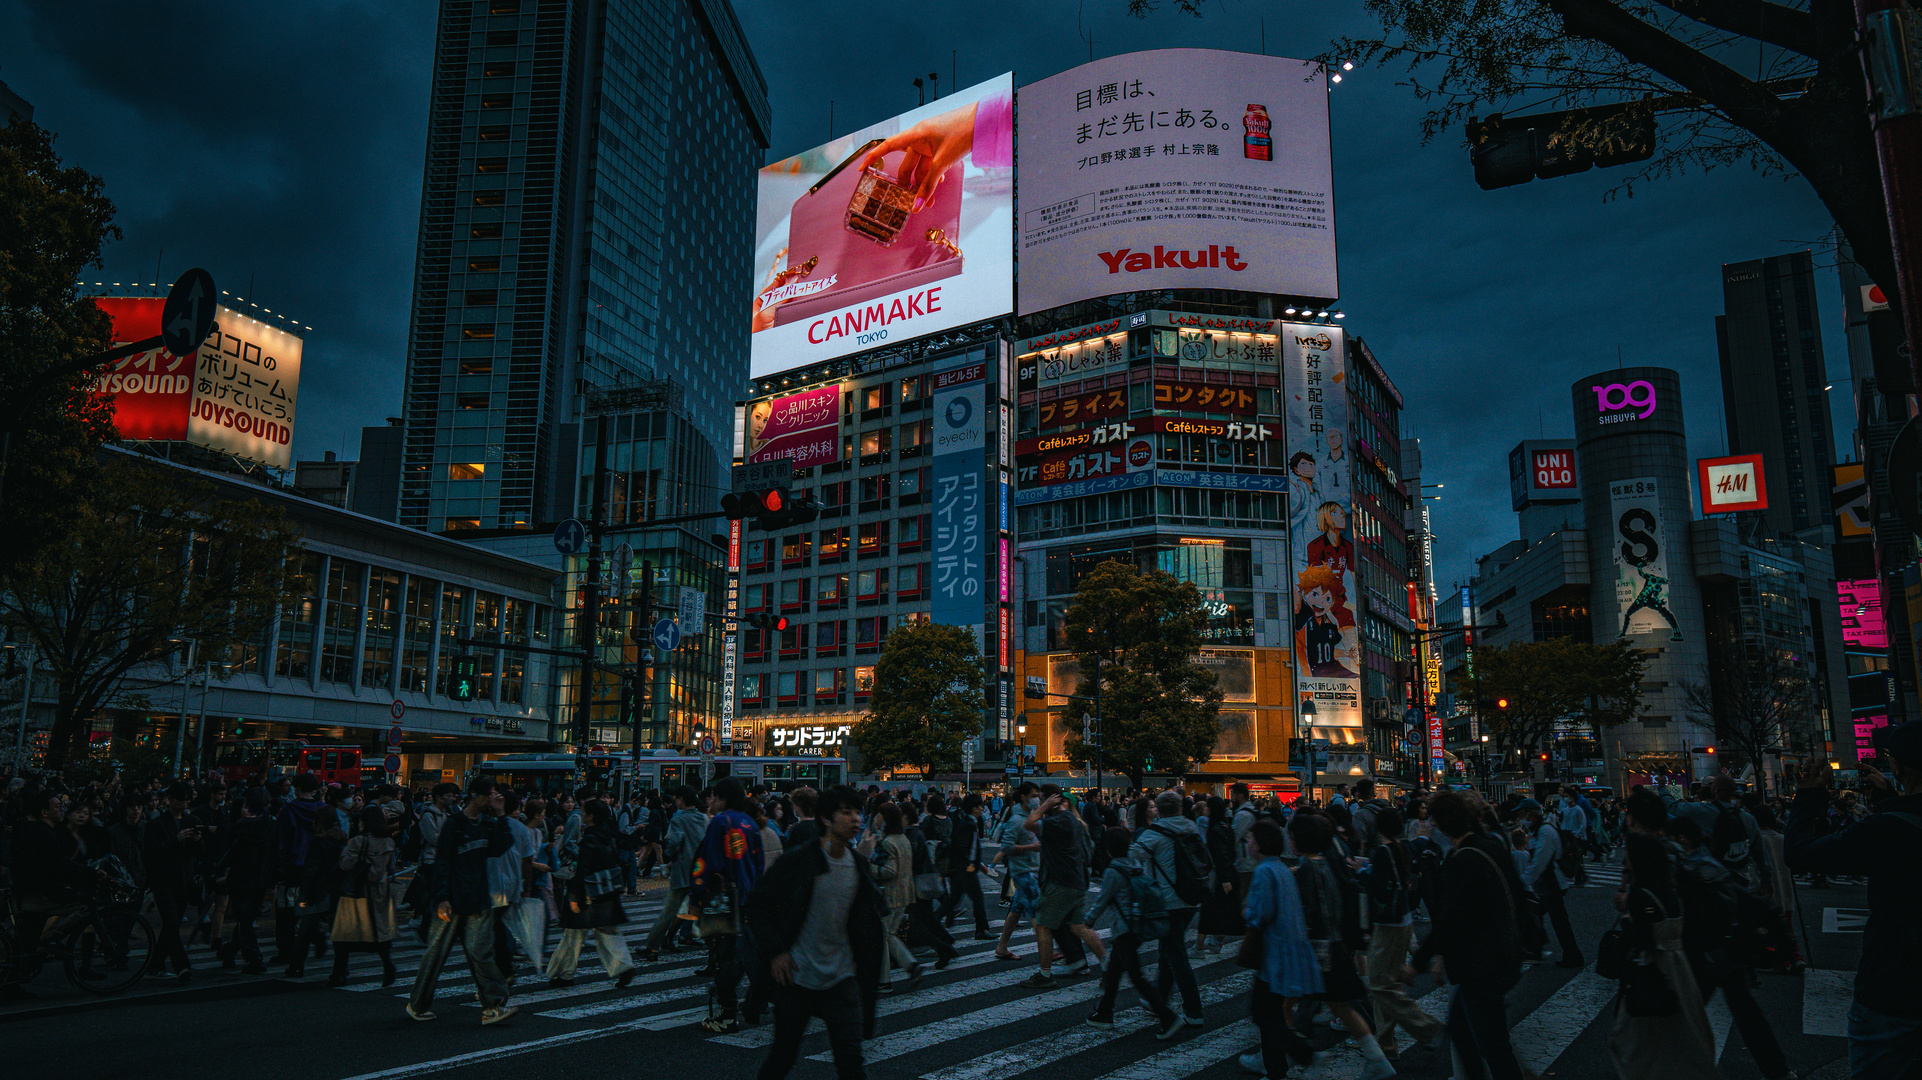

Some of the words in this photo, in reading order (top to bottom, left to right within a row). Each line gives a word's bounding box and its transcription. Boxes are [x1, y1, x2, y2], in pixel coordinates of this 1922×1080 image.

[1076, 79, 1155, 112] 目標は、
[1076, 108, 1230, 145] まだ先にある。
[1077, 146, 1156, 171] プロ野球選手
[1163, 143, 1220, 156] 村上宗隆
[1098, 245, 1248, 274] Yakult
[1727, 273, 1760, 283] INDIGO
[808, 286, 942, 345] CANMAKE
[1169, 312, 1275, 332] しゃぶしゃぶバイキング
[856, 329, 888, 346] TOKYO
[1028, 319, 1122, 351] しゃぶしゃぶバイキング
[203, 330, 277, 371] ココロの
[1069, 342, 1123, 371] しゃぶ葉
[1213, 339, 1275, 362] しゃぶ葉
[200, 353, 293, 404] ボリューム、
[938, 366, 981, 387] 当ビル5F
[1020, 366, 1036, 381] 9F
[197, 376, 292, 423] あげていこう。
[788, 394, 835, 415] 品川スキン
[1040, 388, 1126, 424] プライス
[1154, 384, 1254, 409] コンタクト
[1306, 353, 1324, 453] 好評配信中!
[1592, 380, 1657, 420] 109
[191, 397, 290, 445] JOYSOUND
[788, 409, 830, 428] クリニック
[1598, 412, 1636, 425] SHIBUYA
[938, 428, 979, 446] eyecity
[1092, 421, 1135, 446] ガスト
[1226, 422, 1273, 442] ガスト
[1042, 460, 1066, 475] Café
[1067, 451, 1121, 480] ガスト
[1131, 451, 1150, 461] ガスト
[1536, 453, 1568, 468] UNI
[1019, 464, 1039, 482] 7F
[1162, 472, 1191, 483] AEON
[1538, 470, 1572, 487] QLO
[1717, 473, 1748, 494] H&M
[937, 475, 959, 599] アイシティ
[962, 472, 978, 596] コンタクトの
[1317, 642, 1331, 664] 10
[772, 725, 852, 747] サンドラッグ
[1430, 718, 1443, 758] スギ薬局
[798, 747, 823, 756] CARER
